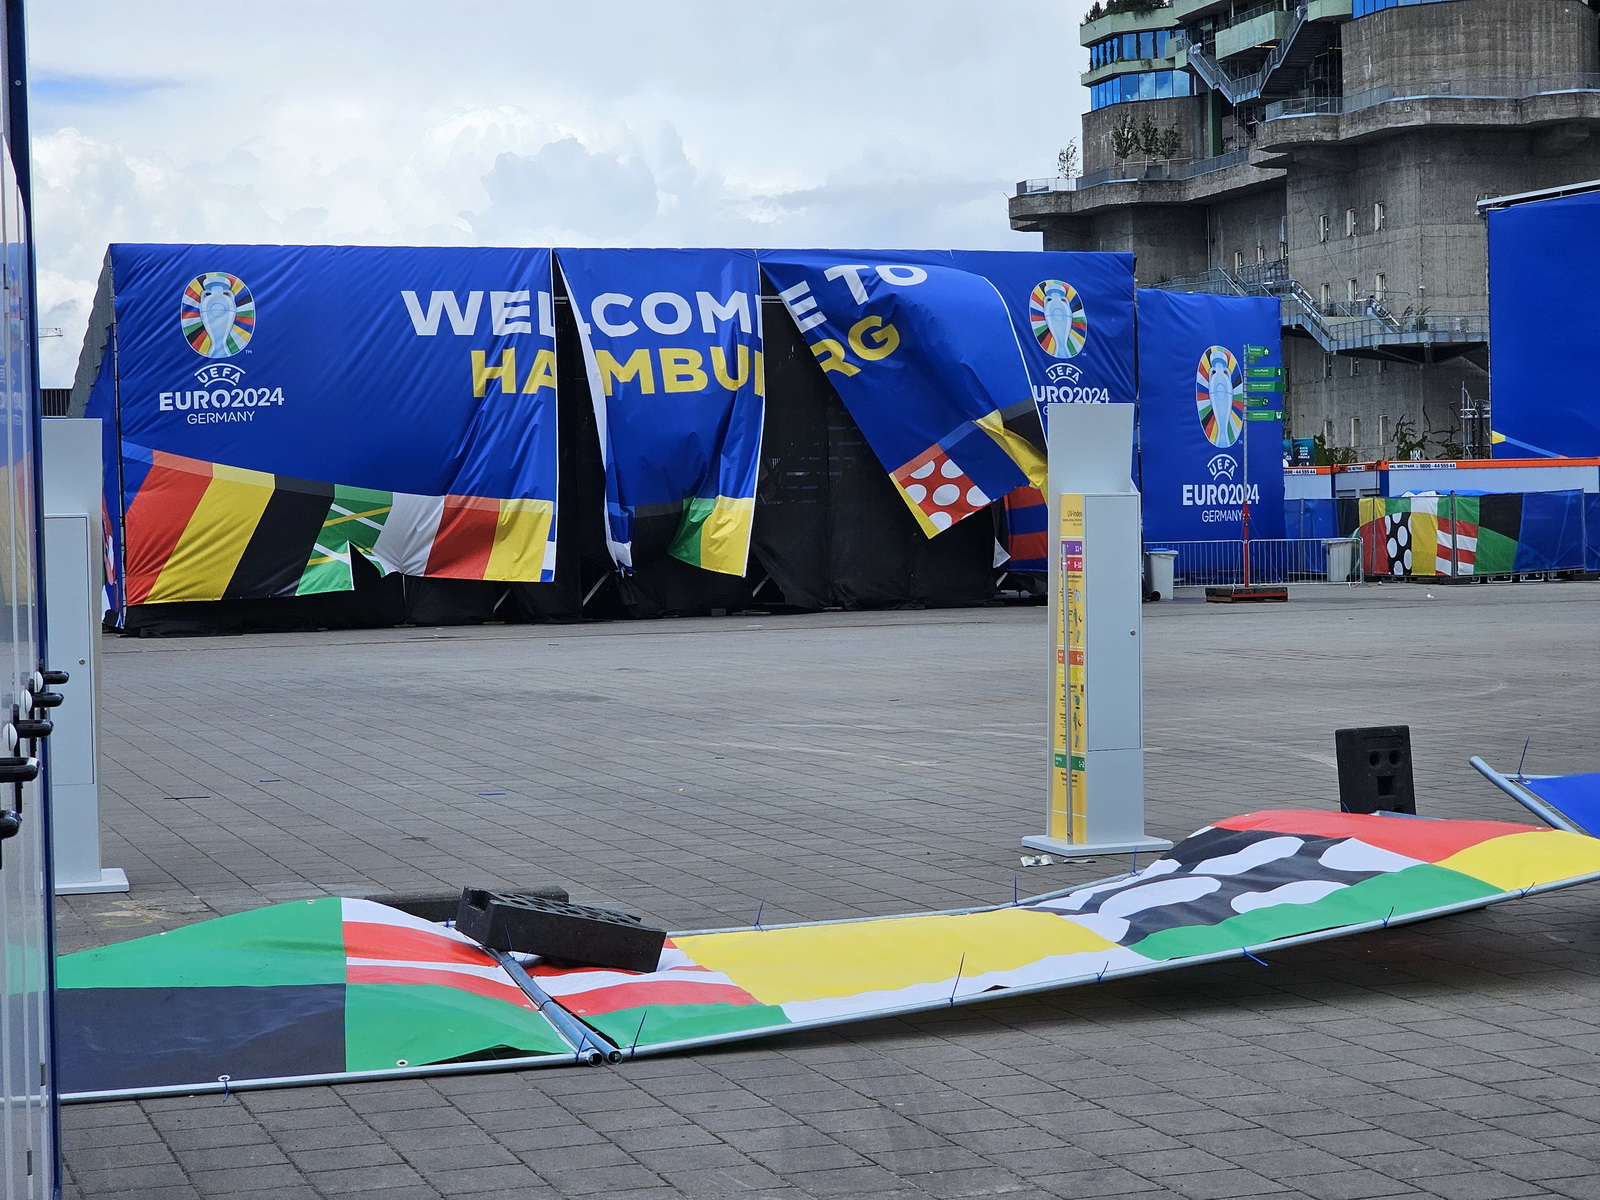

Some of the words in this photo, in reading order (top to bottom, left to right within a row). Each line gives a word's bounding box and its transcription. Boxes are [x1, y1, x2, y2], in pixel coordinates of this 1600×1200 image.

[824, 264, 928, 305] TO
[810, 315, 900, 377] RG
[197, 367, 241, 384] UEFA
[1047, 366, 1080, 382] UEFA
[159, 387, 285, 411] EURO2024
[1033, 385, 1110, 404] URO2024
[187, 411, 255, 425] GERMANY
[1209, 458, 1235, 477] UEFA
[1201, 509, 1243, 523] GERMANY
